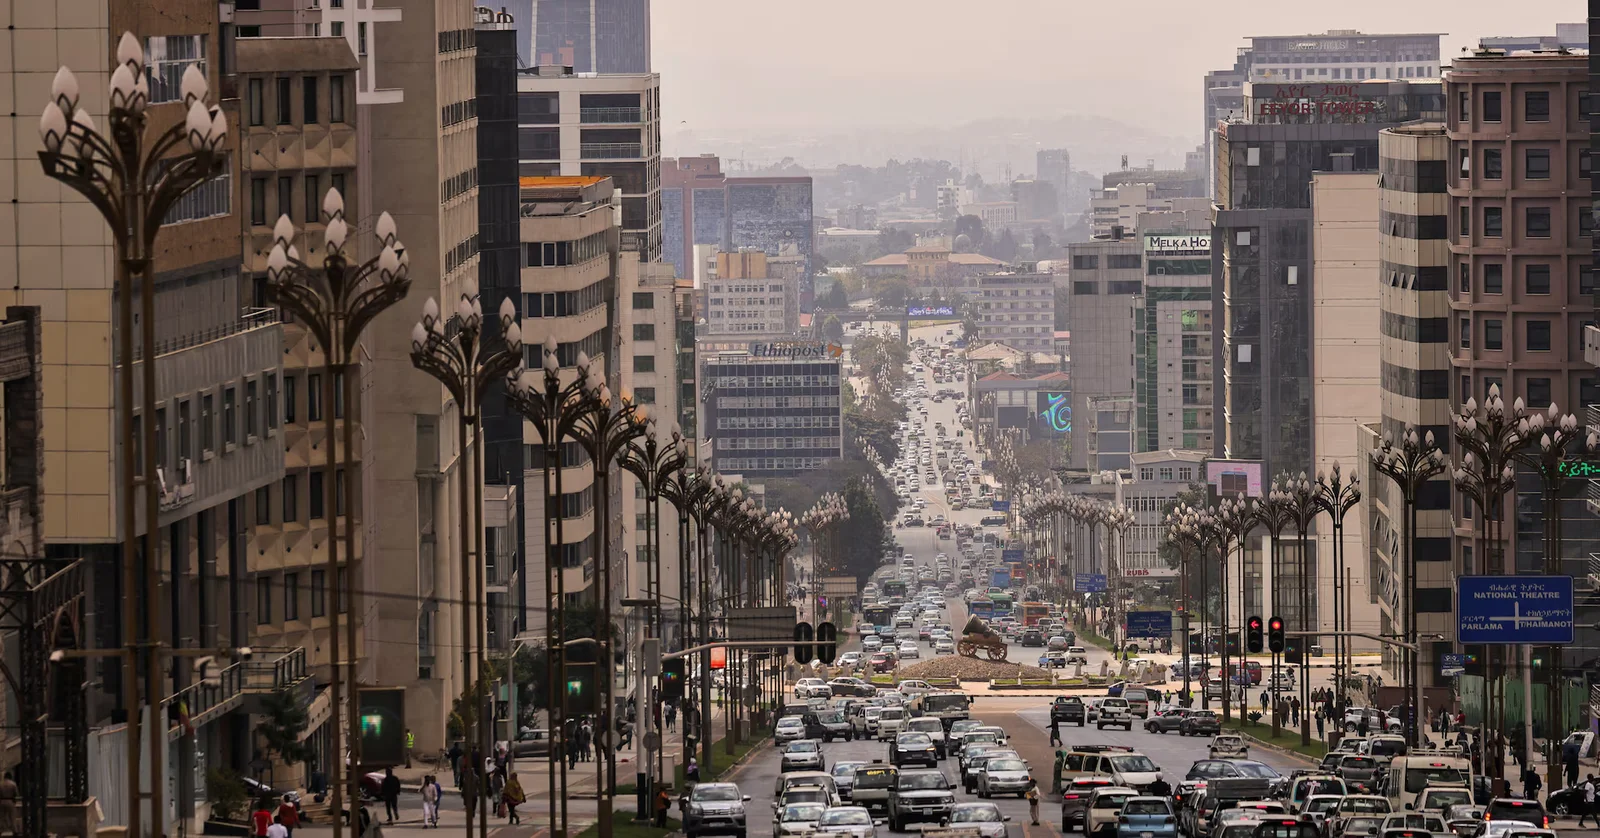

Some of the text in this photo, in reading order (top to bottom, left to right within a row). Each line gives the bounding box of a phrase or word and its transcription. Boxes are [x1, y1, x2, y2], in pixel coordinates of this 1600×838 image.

[1318, 100, 1375, 115] TOWER
[1150, 236, 1187, 247] MELKA
[754, 342, 825, 360] Ethiopost
[1474, 591, 1560, 599] NATIONAL THEATRE
[1520, 620, 1572, 628] T/HAIMANOT
